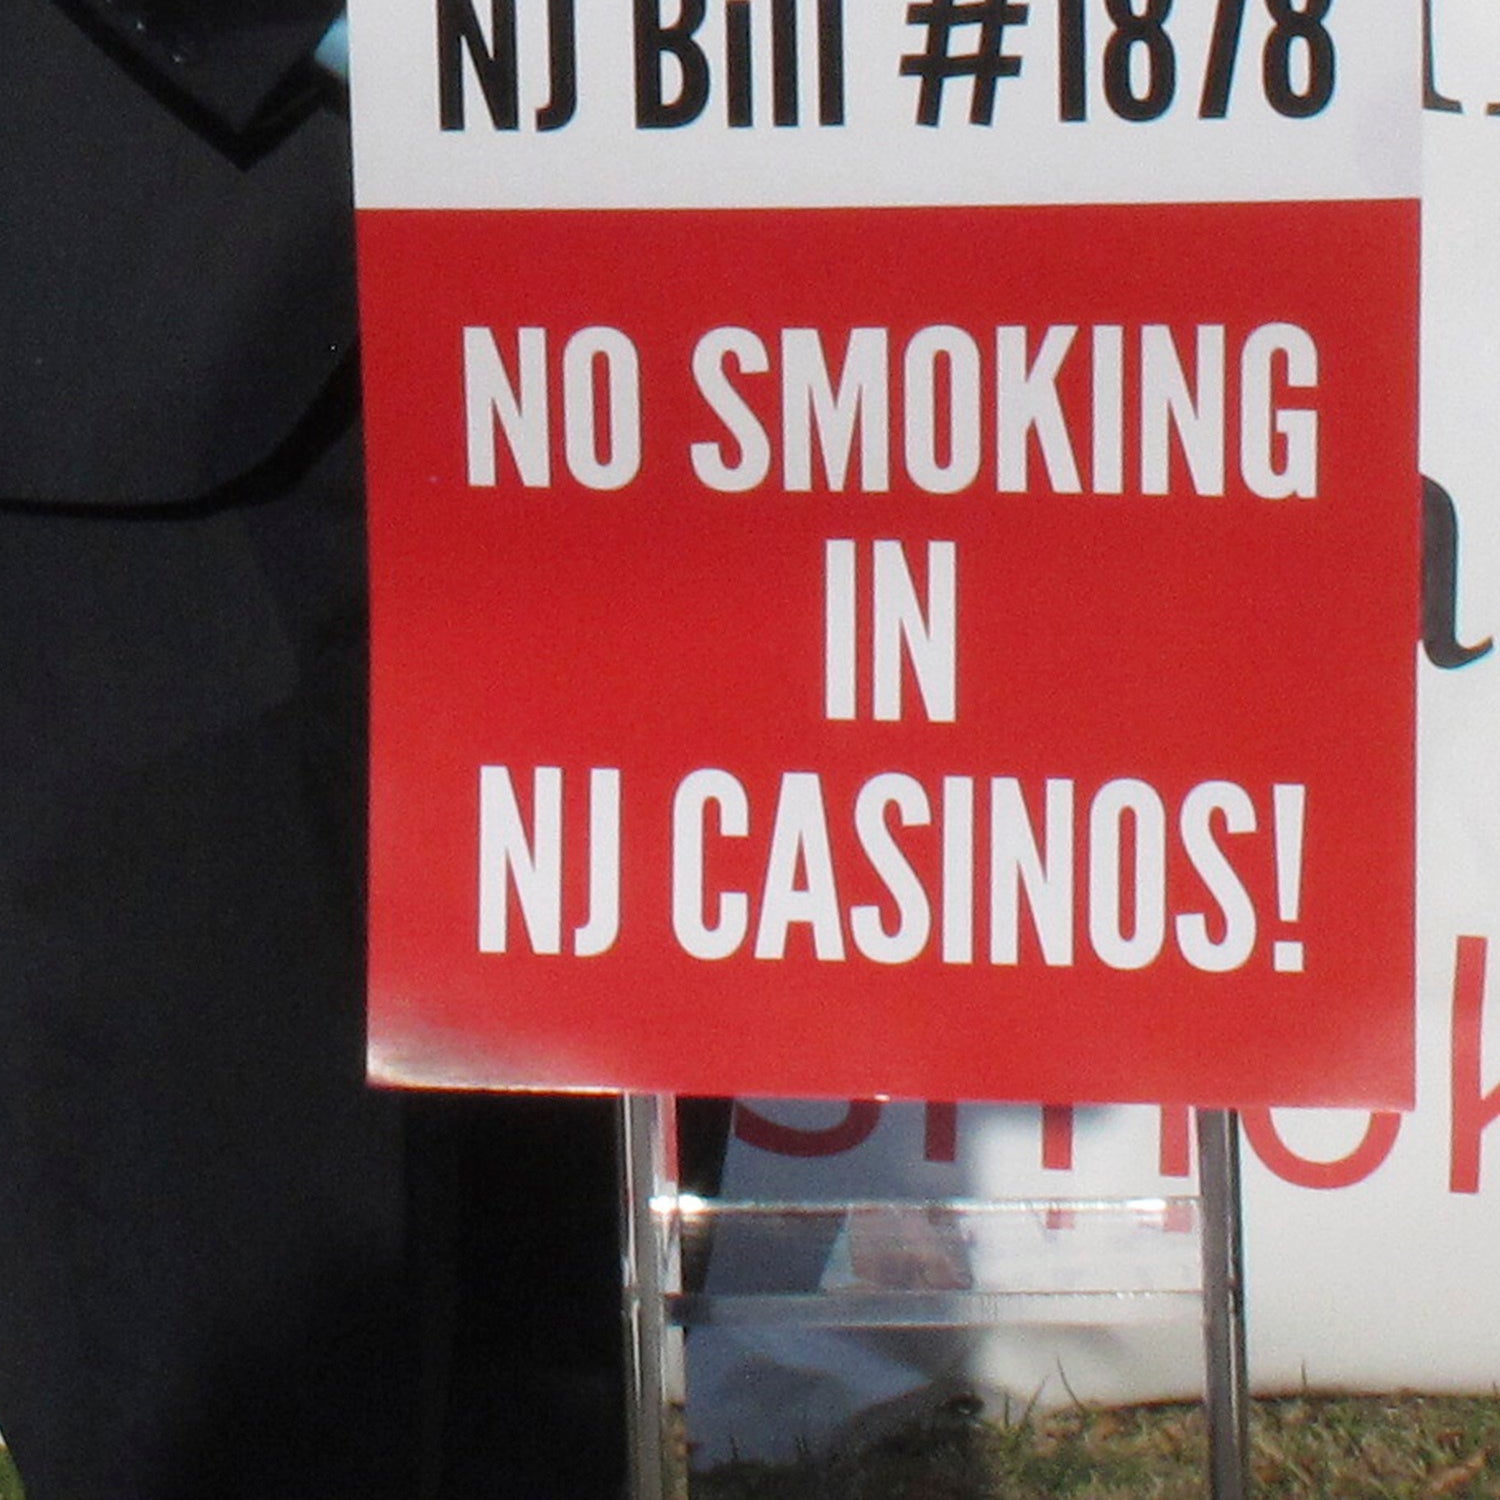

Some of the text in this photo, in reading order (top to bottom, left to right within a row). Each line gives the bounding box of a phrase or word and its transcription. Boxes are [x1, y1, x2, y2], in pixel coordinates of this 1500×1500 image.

[461, 320, 1320, 501] NO SMOKING
[822, 537, 958, 723] IN
[475, 762, 1307, 975] NJ CASINOS!
